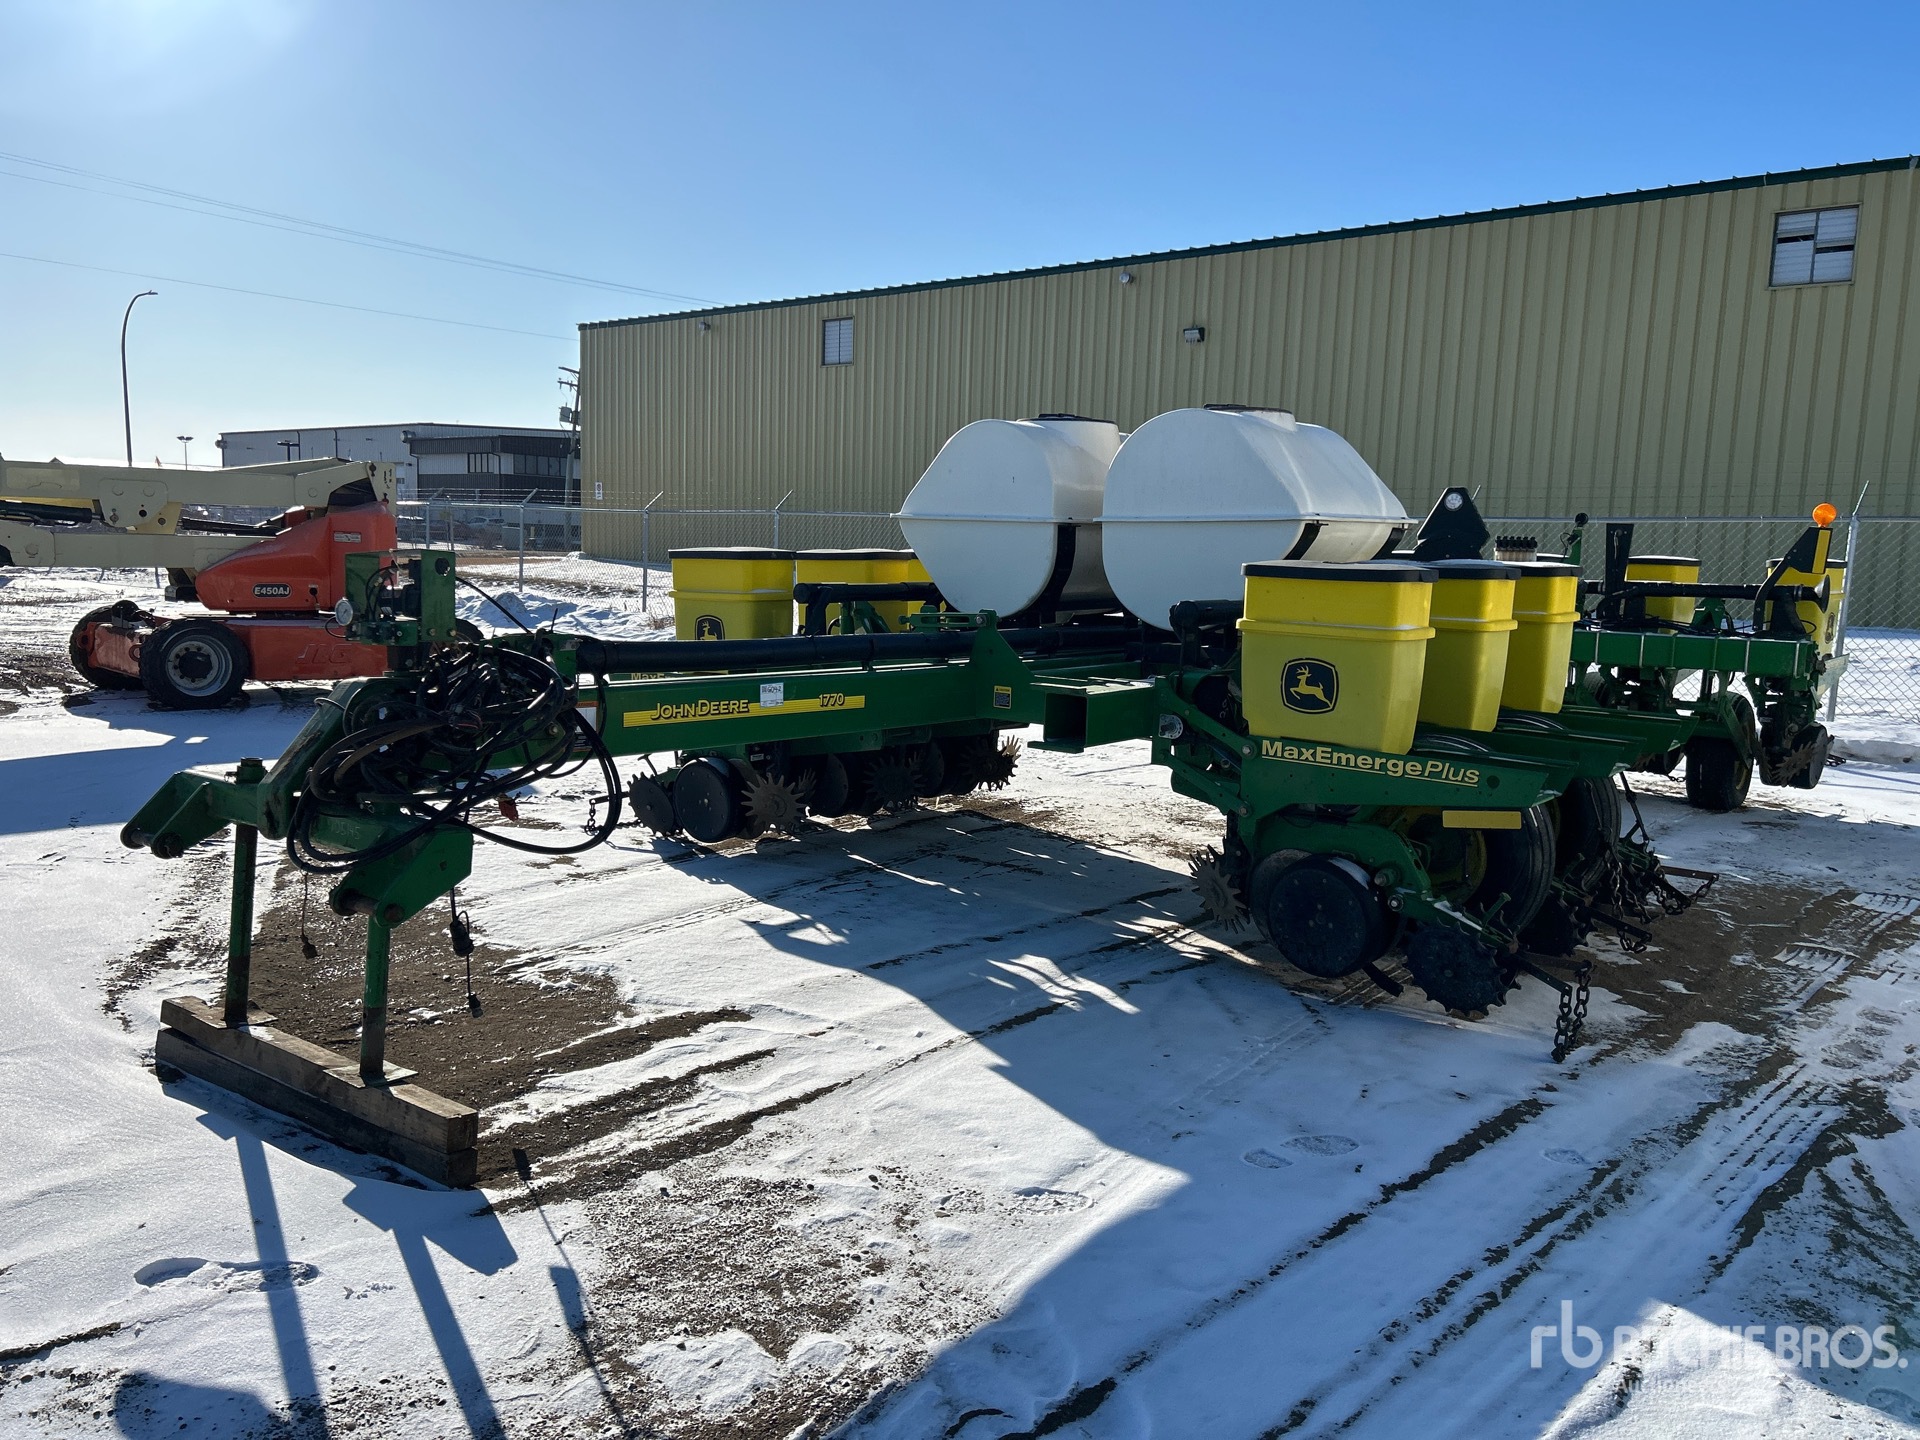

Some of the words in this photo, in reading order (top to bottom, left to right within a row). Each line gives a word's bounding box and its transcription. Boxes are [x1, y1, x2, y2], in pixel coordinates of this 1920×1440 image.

[254, 587, 290, 595] E450AJ
[296, 644, 351, 664] JLG
[819, 692, 845, 707] 1770
